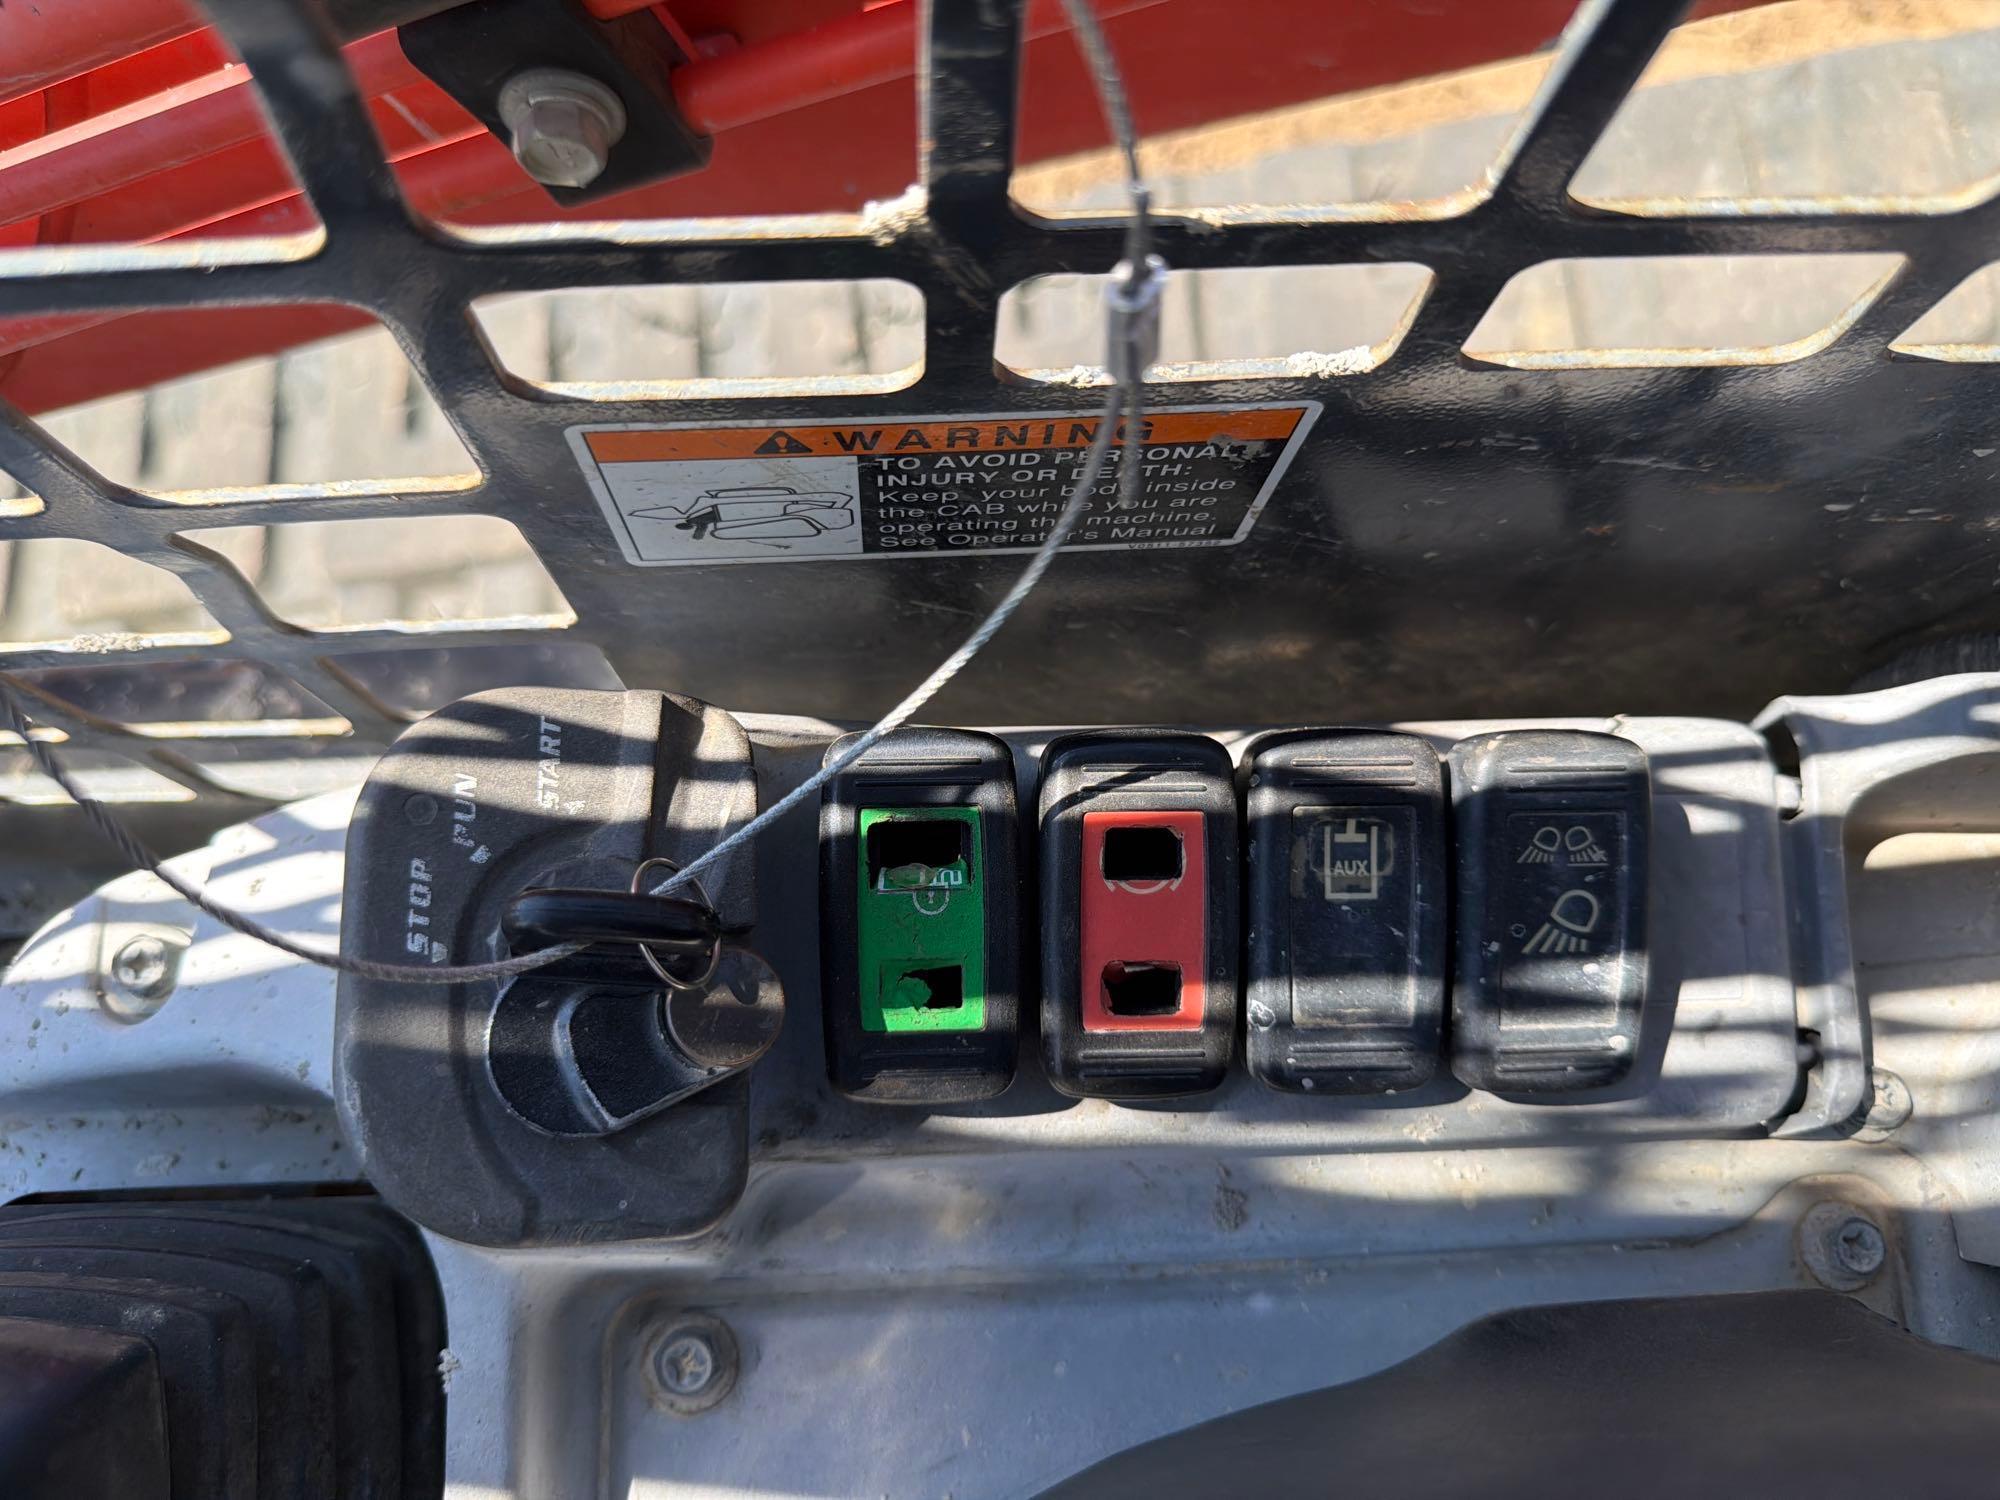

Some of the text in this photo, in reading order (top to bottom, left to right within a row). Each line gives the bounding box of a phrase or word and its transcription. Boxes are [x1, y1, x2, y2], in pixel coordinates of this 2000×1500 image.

[833, 421, 1154, 451] WARNING
[874, 457, 921, 470] TO
[934, 452, 1041, 469] AVOID
[877, 463, 1193, 487] INJURY OR DETH:
[879, 490, 959, 503] Keep
[981, 487, 1049, 502] your
[1146, 478, 1236, 493] inside
[878, 507, 925, 519] the
[937, 503, 1005, 517] CAB
[1017, 500, 1093, 514] whie
[1169, 497, 1218, 508] are
[879, 511, 1217, 535] operating th machine.
[880, 524, 1216, 548] See Operatr's Manual
[537, 716, 562, 810] START
[1333, 860, 1369, 877] AUX
[407, 858, 432, 954] STOP
